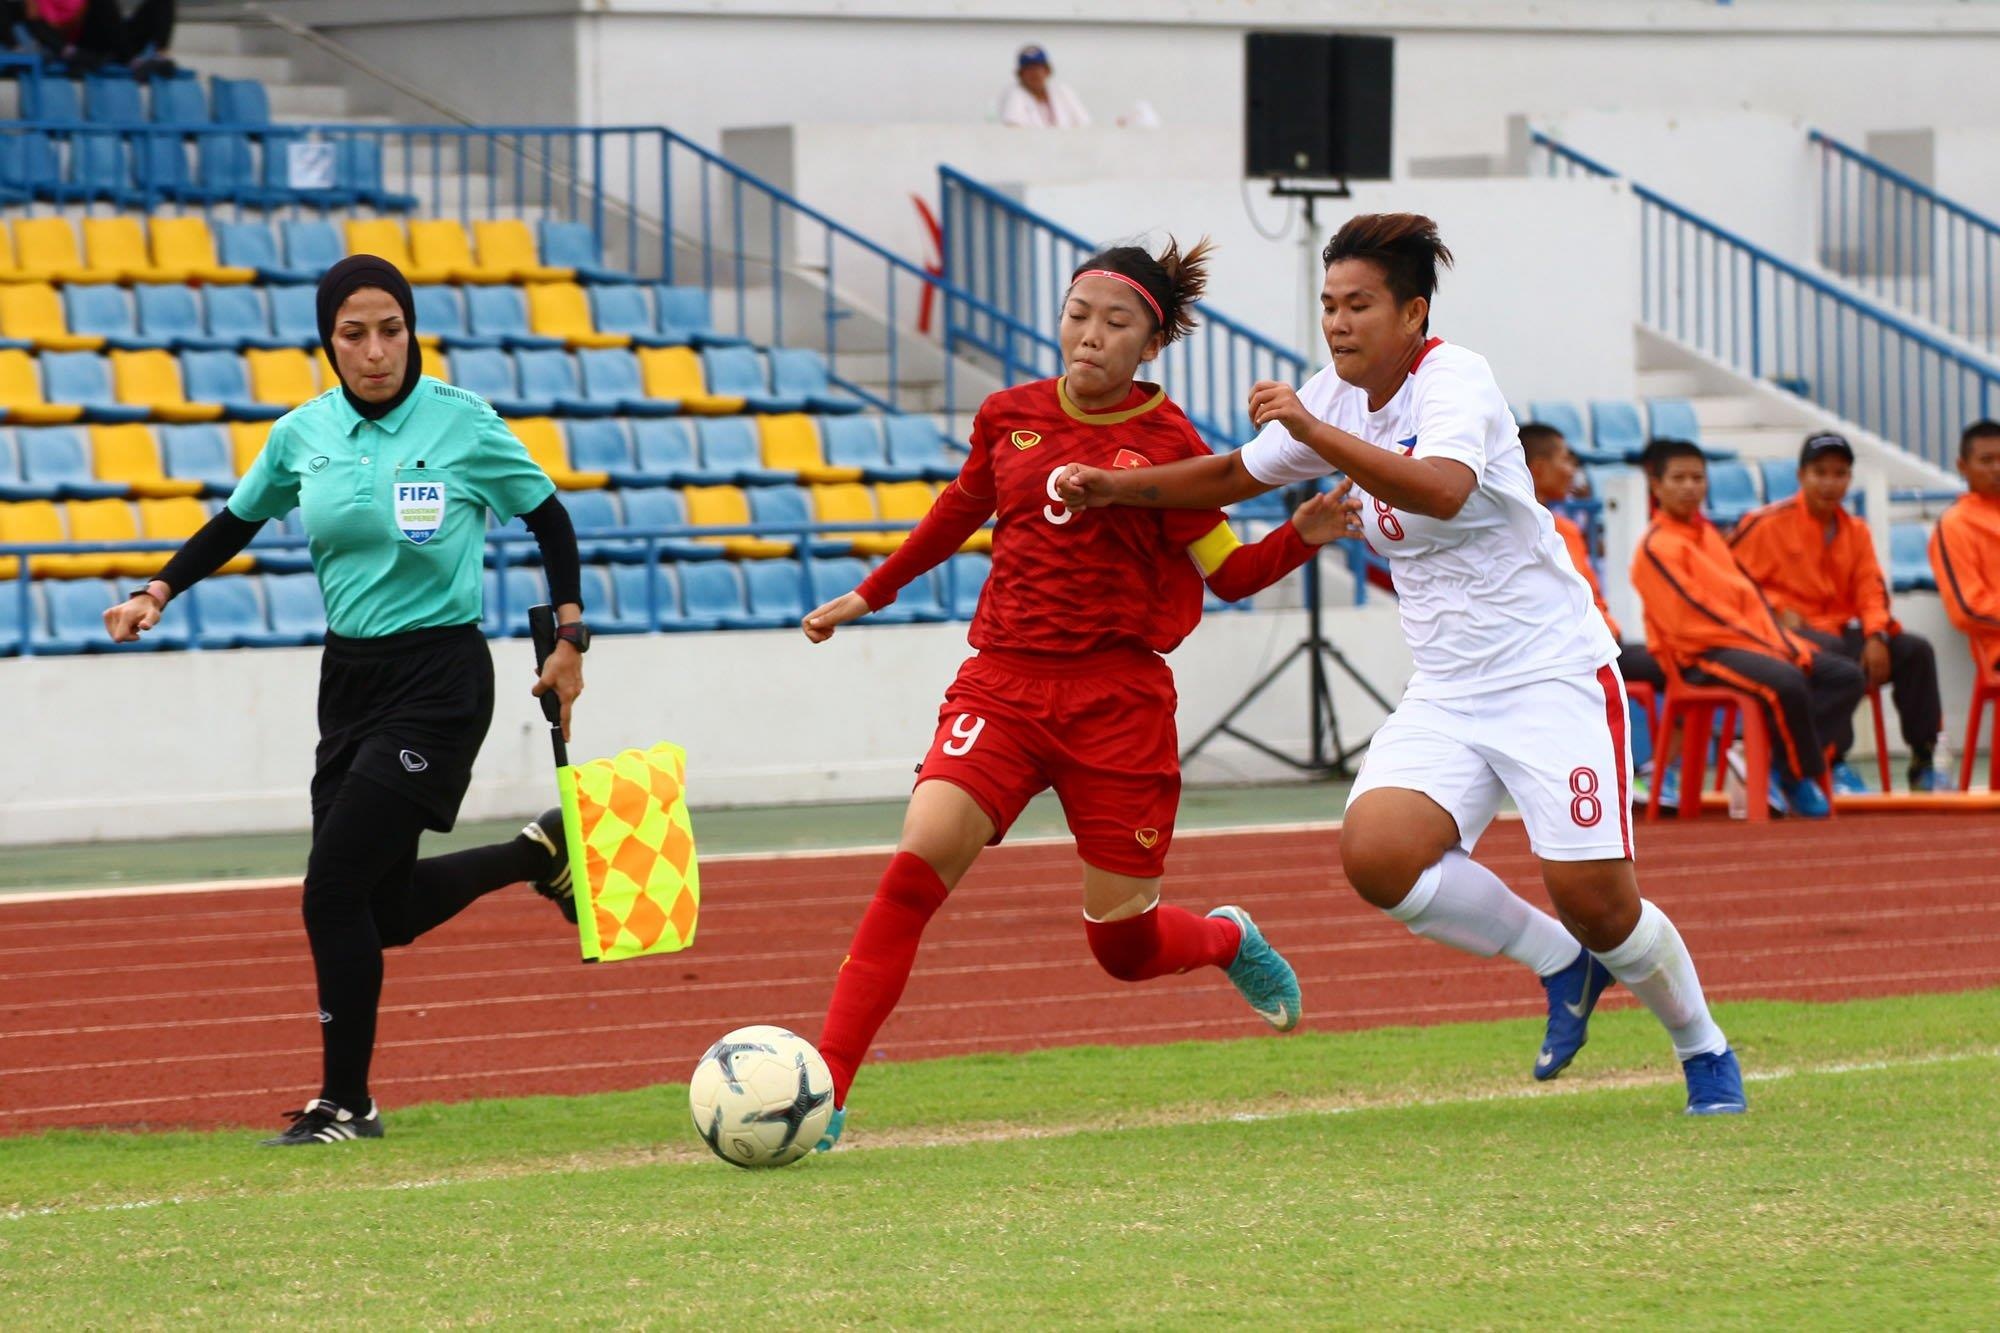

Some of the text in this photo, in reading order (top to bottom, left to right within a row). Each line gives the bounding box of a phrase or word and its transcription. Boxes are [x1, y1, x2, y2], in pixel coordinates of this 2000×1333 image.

[399, 486, 439, 501] FIFA
[942, 712, 986, 757] 9
[1569, 766, 1602, 828] 8
